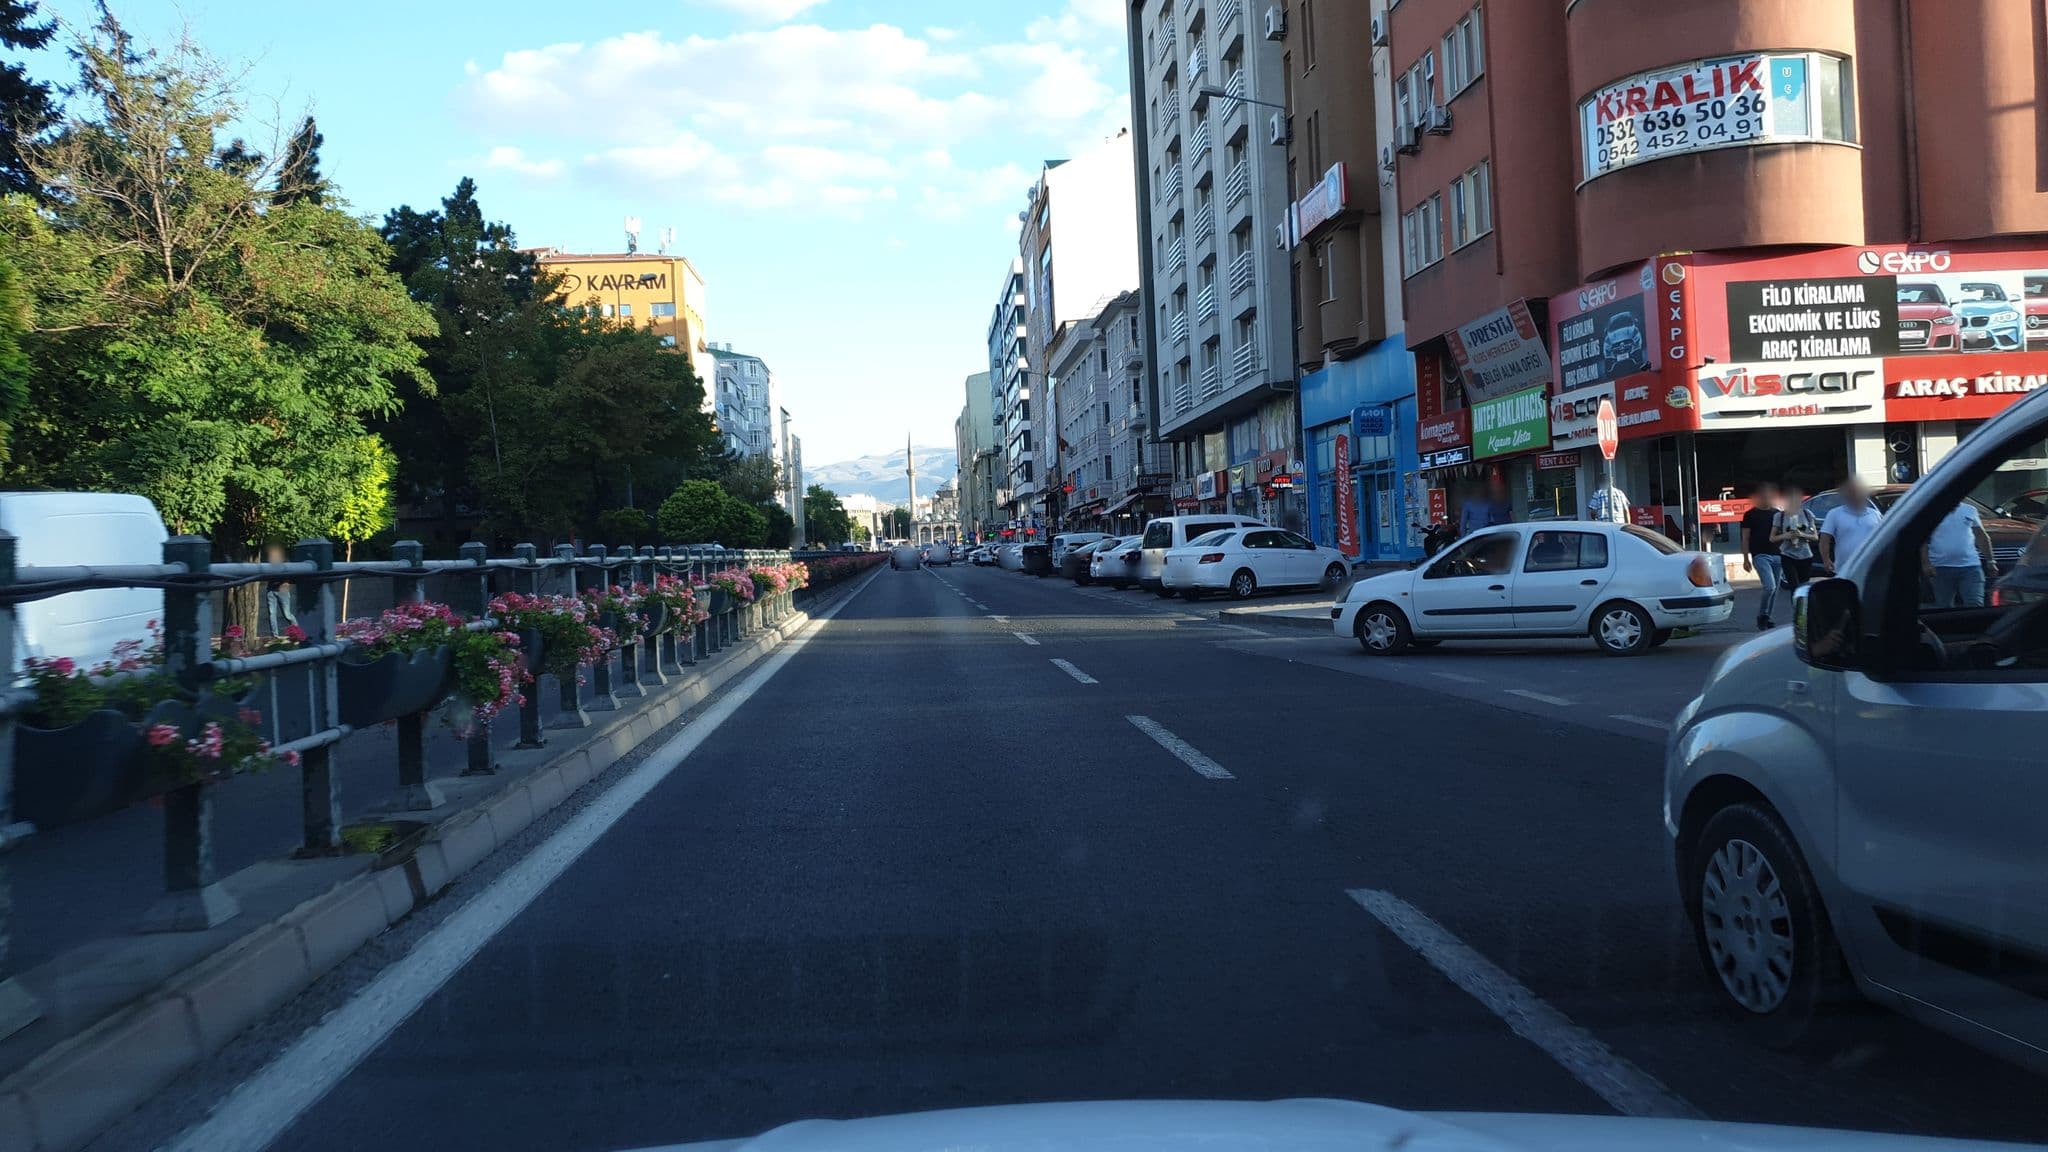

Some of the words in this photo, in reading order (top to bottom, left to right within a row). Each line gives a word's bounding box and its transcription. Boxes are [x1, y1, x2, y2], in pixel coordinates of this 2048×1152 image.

[1597, 117, 1636, 147] 0532
[1642, 107, 1686, 134] 636
[1695, 100, 1726, 123] 50
[1735, 92, 1767, 116] 36
[1598, 140, 1640, 163] 0542
[1646, 130, 1689, 151] 452
[1697, 123, 1728, 140] 04
[1735, 116, 1764, 134] 91
[1883, 250, 1951, 273] EXPO
[586, 273, 666, 292] KAVRAM
[1588, 280, 1617, 307] EXPO
[1762, 284, 1792, 307] FİLO
[1794, 283, 1865, 306] KİRALAMA
[1469, 315, 1514, 347] PRESTİJ
[1669, 290, 1685, 359] EXPO
[1749, 309, 1821, 334] EKONOMİK
[1823, 312, 1843, 331] VE
[1844, 309, 1881, 330] LÜKS
[1761, 342, 1798, 362] ARAÇ
[1800, 335, 1871, 358] KİRALAMA
[1898, 374, 1969, 398] ARAÇ
[1473, 405, 1496, 433] ANTEP
[1770, 403, 1819, 418] rental
[1599, 419, 1618, 441] DUR
[1539, 456, 1558, 467] RENT
